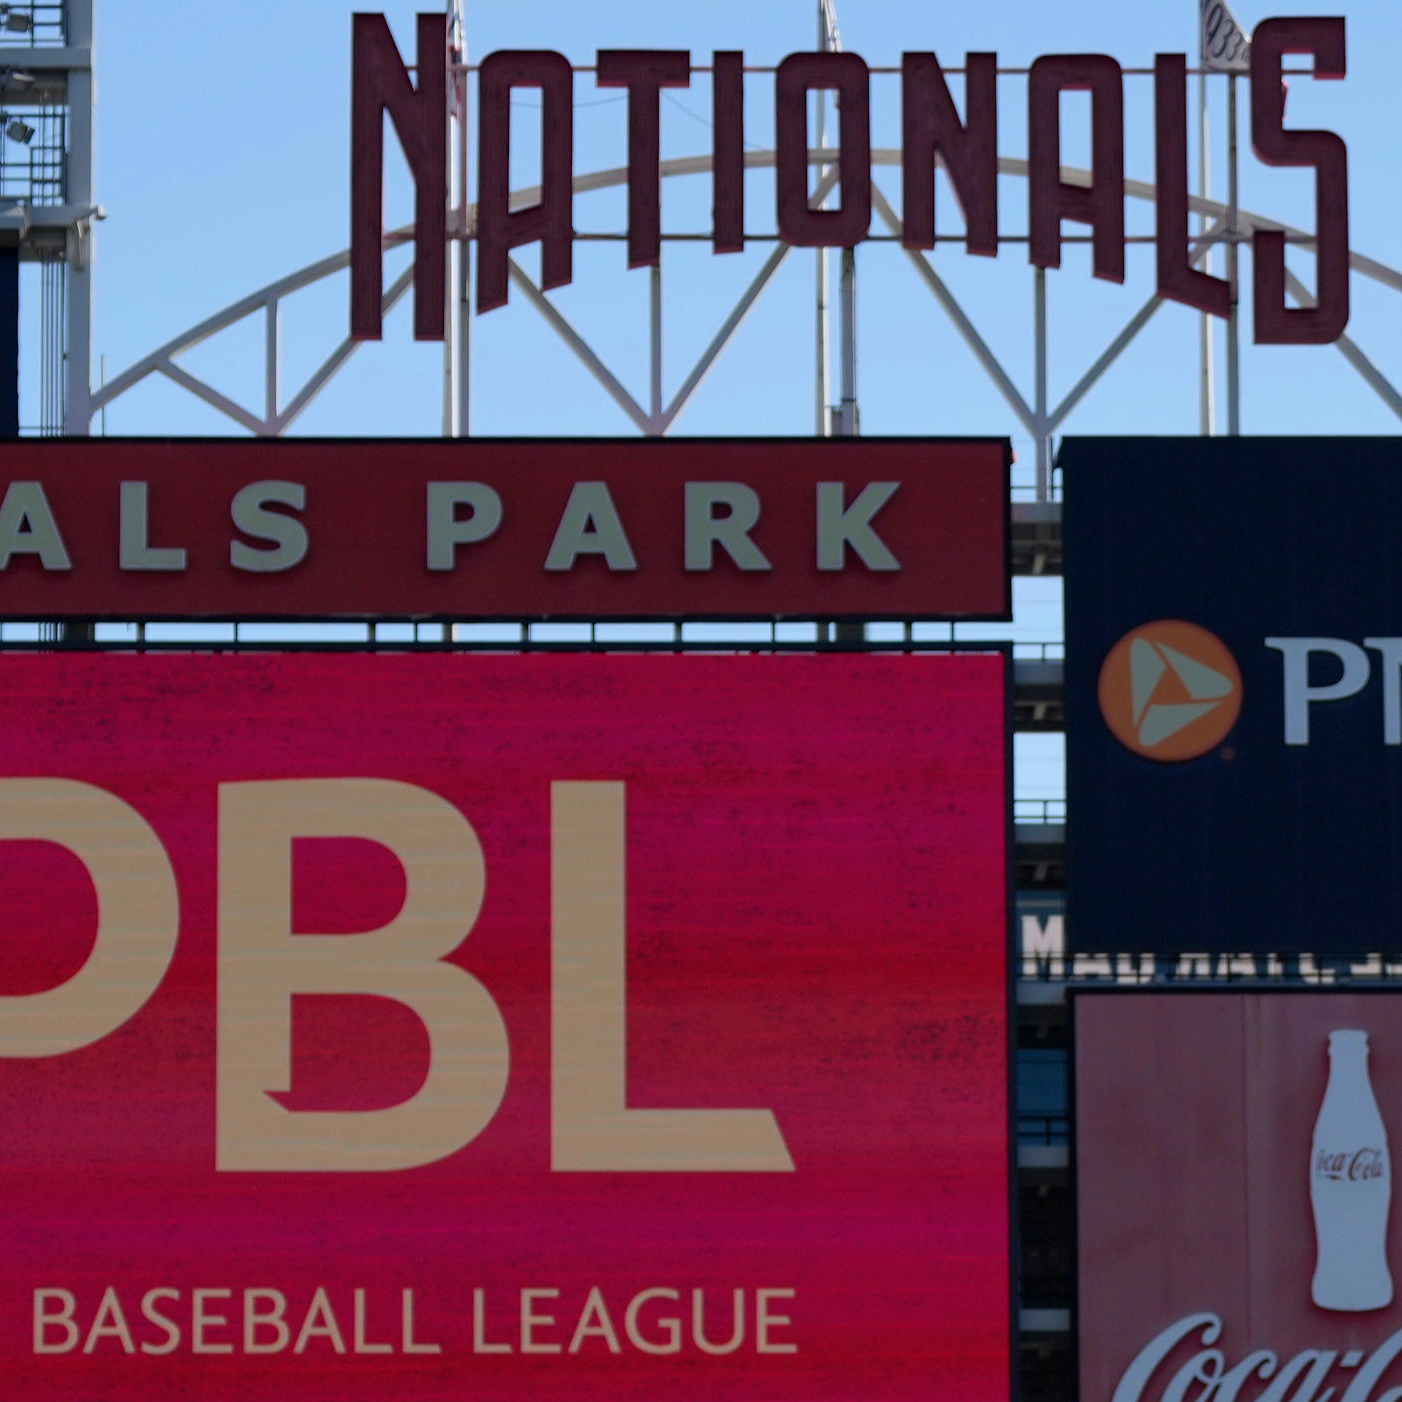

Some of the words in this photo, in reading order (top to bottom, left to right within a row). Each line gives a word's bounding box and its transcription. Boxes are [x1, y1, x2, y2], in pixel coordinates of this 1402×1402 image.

[351, 12, 1349, 344] NATIONALS
[426, 479, 901, 573] PARK
[32, 1287, 441, 1355] BASEBALL
[472, 1287, 798, 1355] LEAGUE
